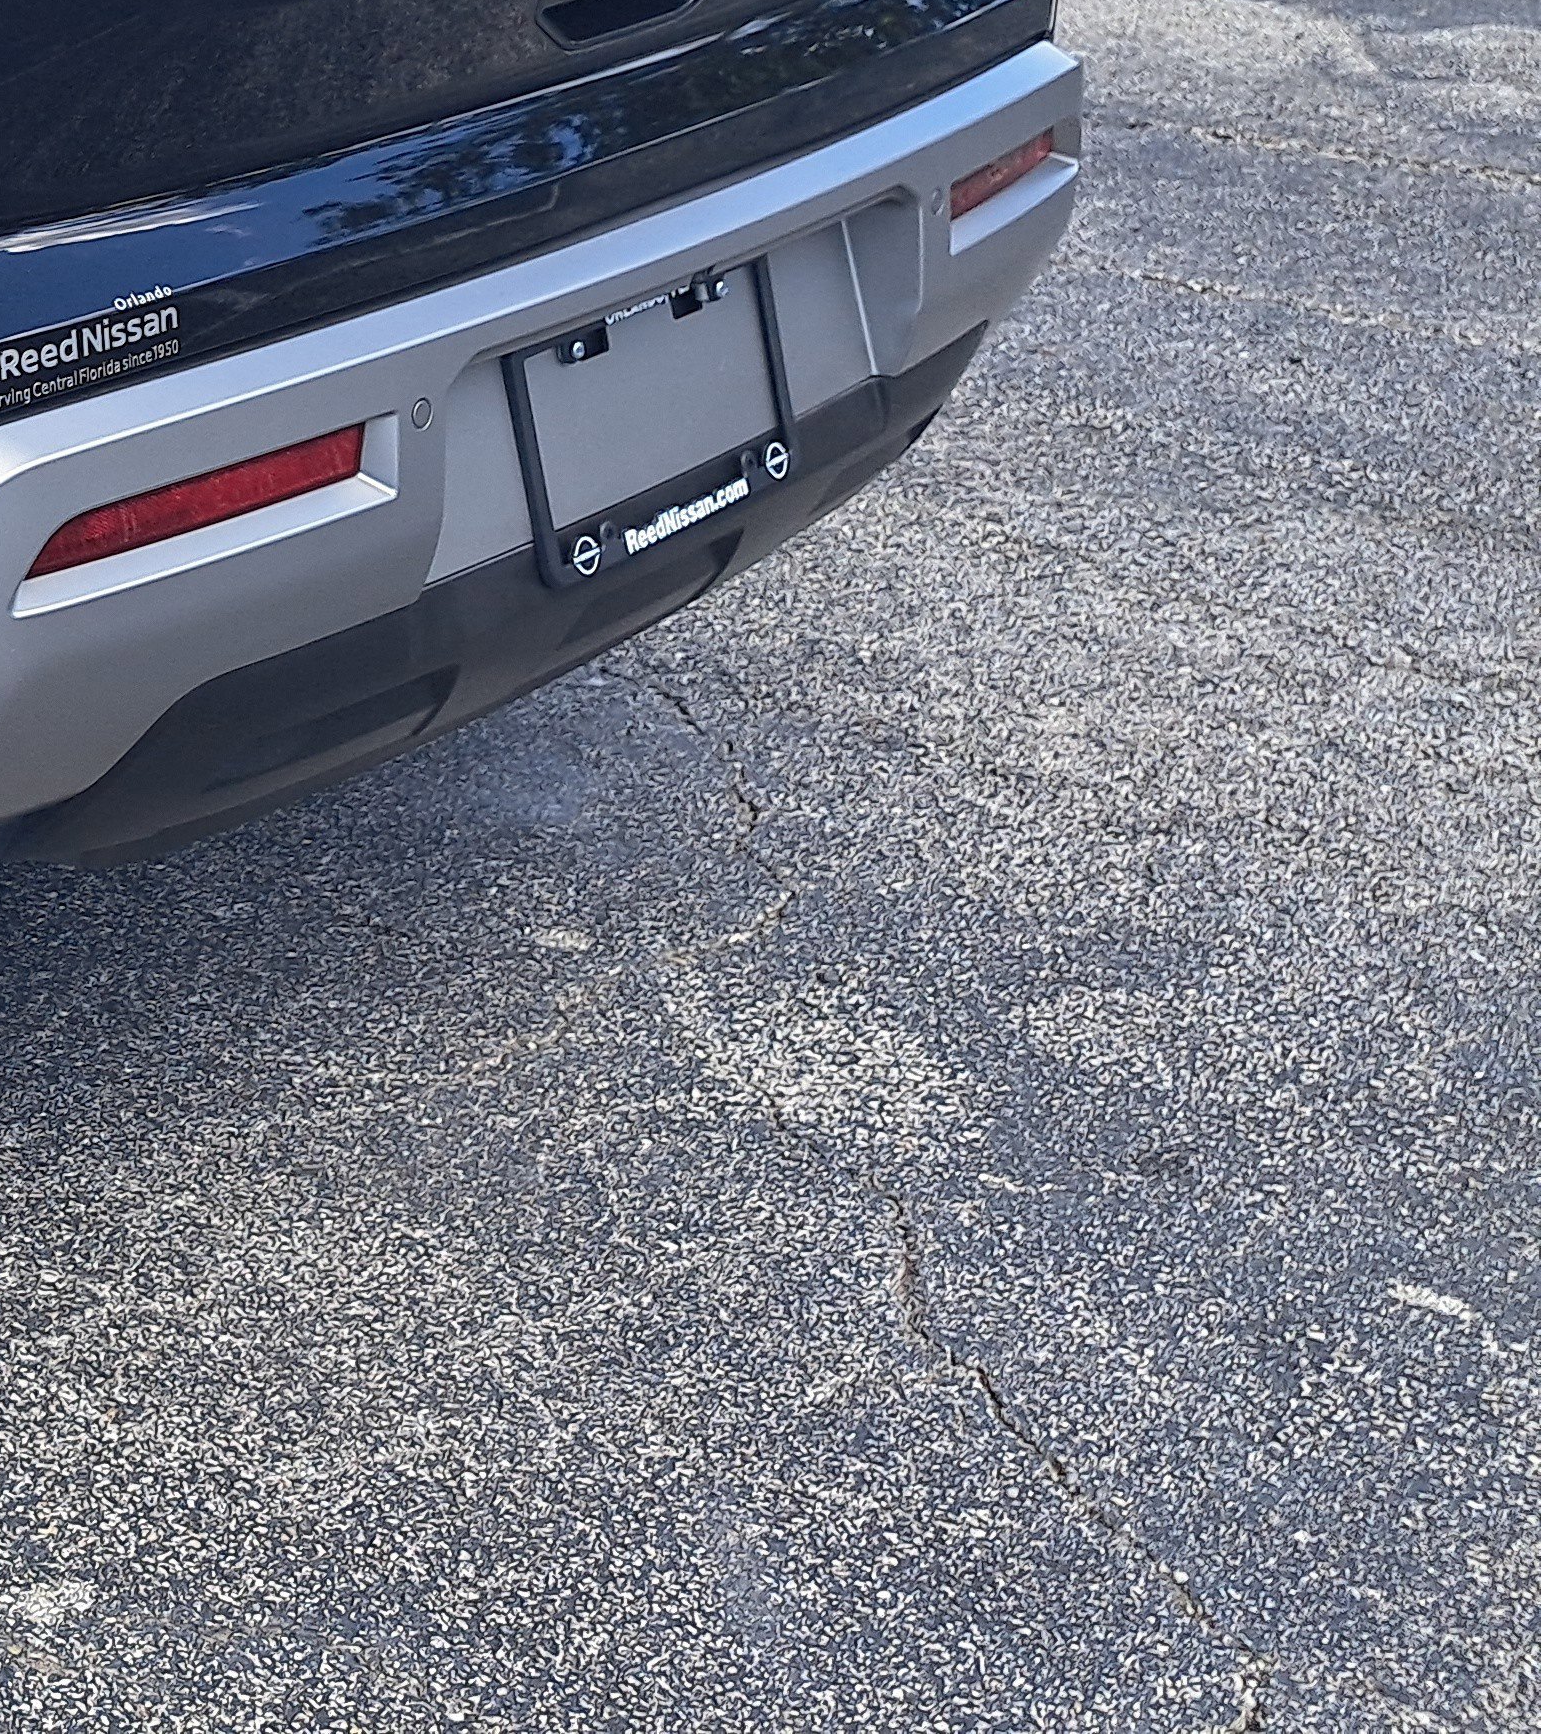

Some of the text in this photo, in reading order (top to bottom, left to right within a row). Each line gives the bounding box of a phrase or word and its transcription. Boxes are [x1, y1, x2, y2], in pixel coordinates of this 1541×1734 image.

[113, 284, 173, 311] Orlando
[32, 368, 78, 397] Central
[79, 359, 121, 384] Florida
[624, 477, 749, 556] ReedNissan.com
